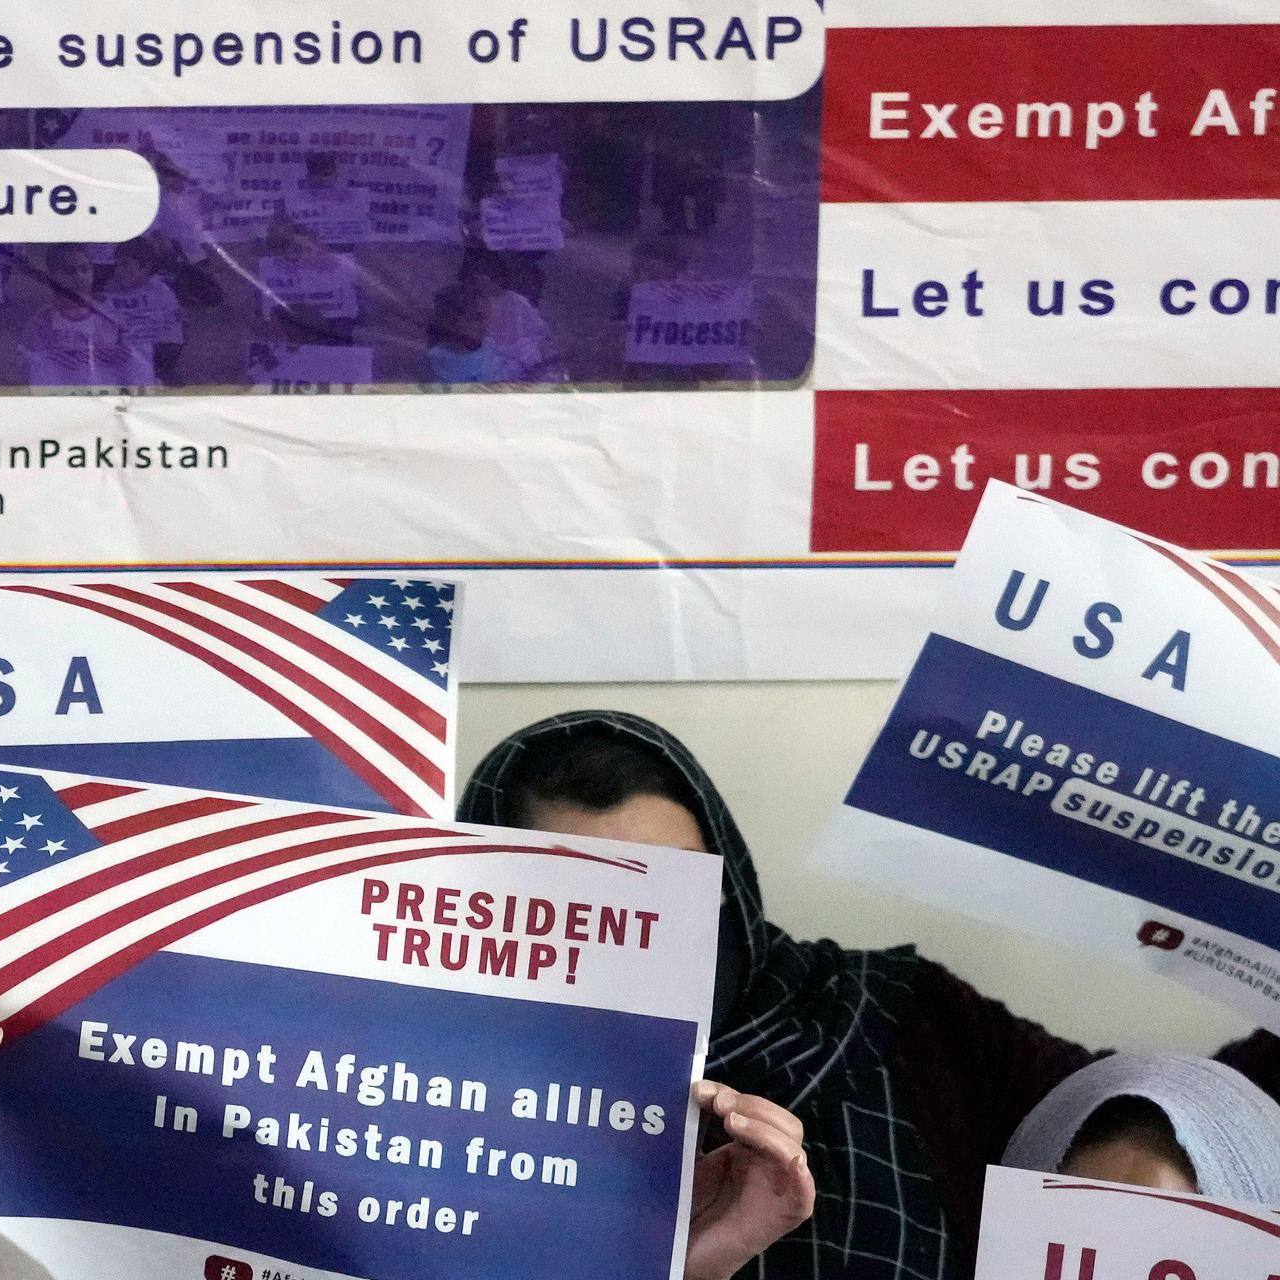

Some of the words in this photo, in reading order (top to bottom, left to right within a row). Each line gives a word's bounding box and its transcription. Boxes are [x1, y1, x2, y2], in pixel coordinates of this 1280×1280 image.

[58, 20, 423, 78] suspension
[468, 19, 530, 63] of
[570, 16, 804, 63] USRAP
[868, 91, 1159, 150] Exempt
[1190, 88, 1280, 138] Af
[862, 269, 985, 318] Let
[1027, 278, 1116, 317] us
[854, 443, 975, 492] Let
[1014, 450, 1102, 490] us
[993, 568, 1192, 693] USA
[908, 728, 1054, 798] USRAP
[977, 709, 1121, 785] Please
[1132, 767, 1206, 817] lift
[360, 878, 660, 950] PRESIDENT
[371, 921, 582, 986] TRUMP!
[77, 1020, 280, 1088] Exempt
[295, 1049, 488, 1117] Afghan
[510, 1084, 667, 1137] allies
[222, 1103, 445, 1170] Pakistan
[465, 1142, 579, 1190] from
[253, 1172, 339, 1221] this
[356, 1184, 482, 1236] order
